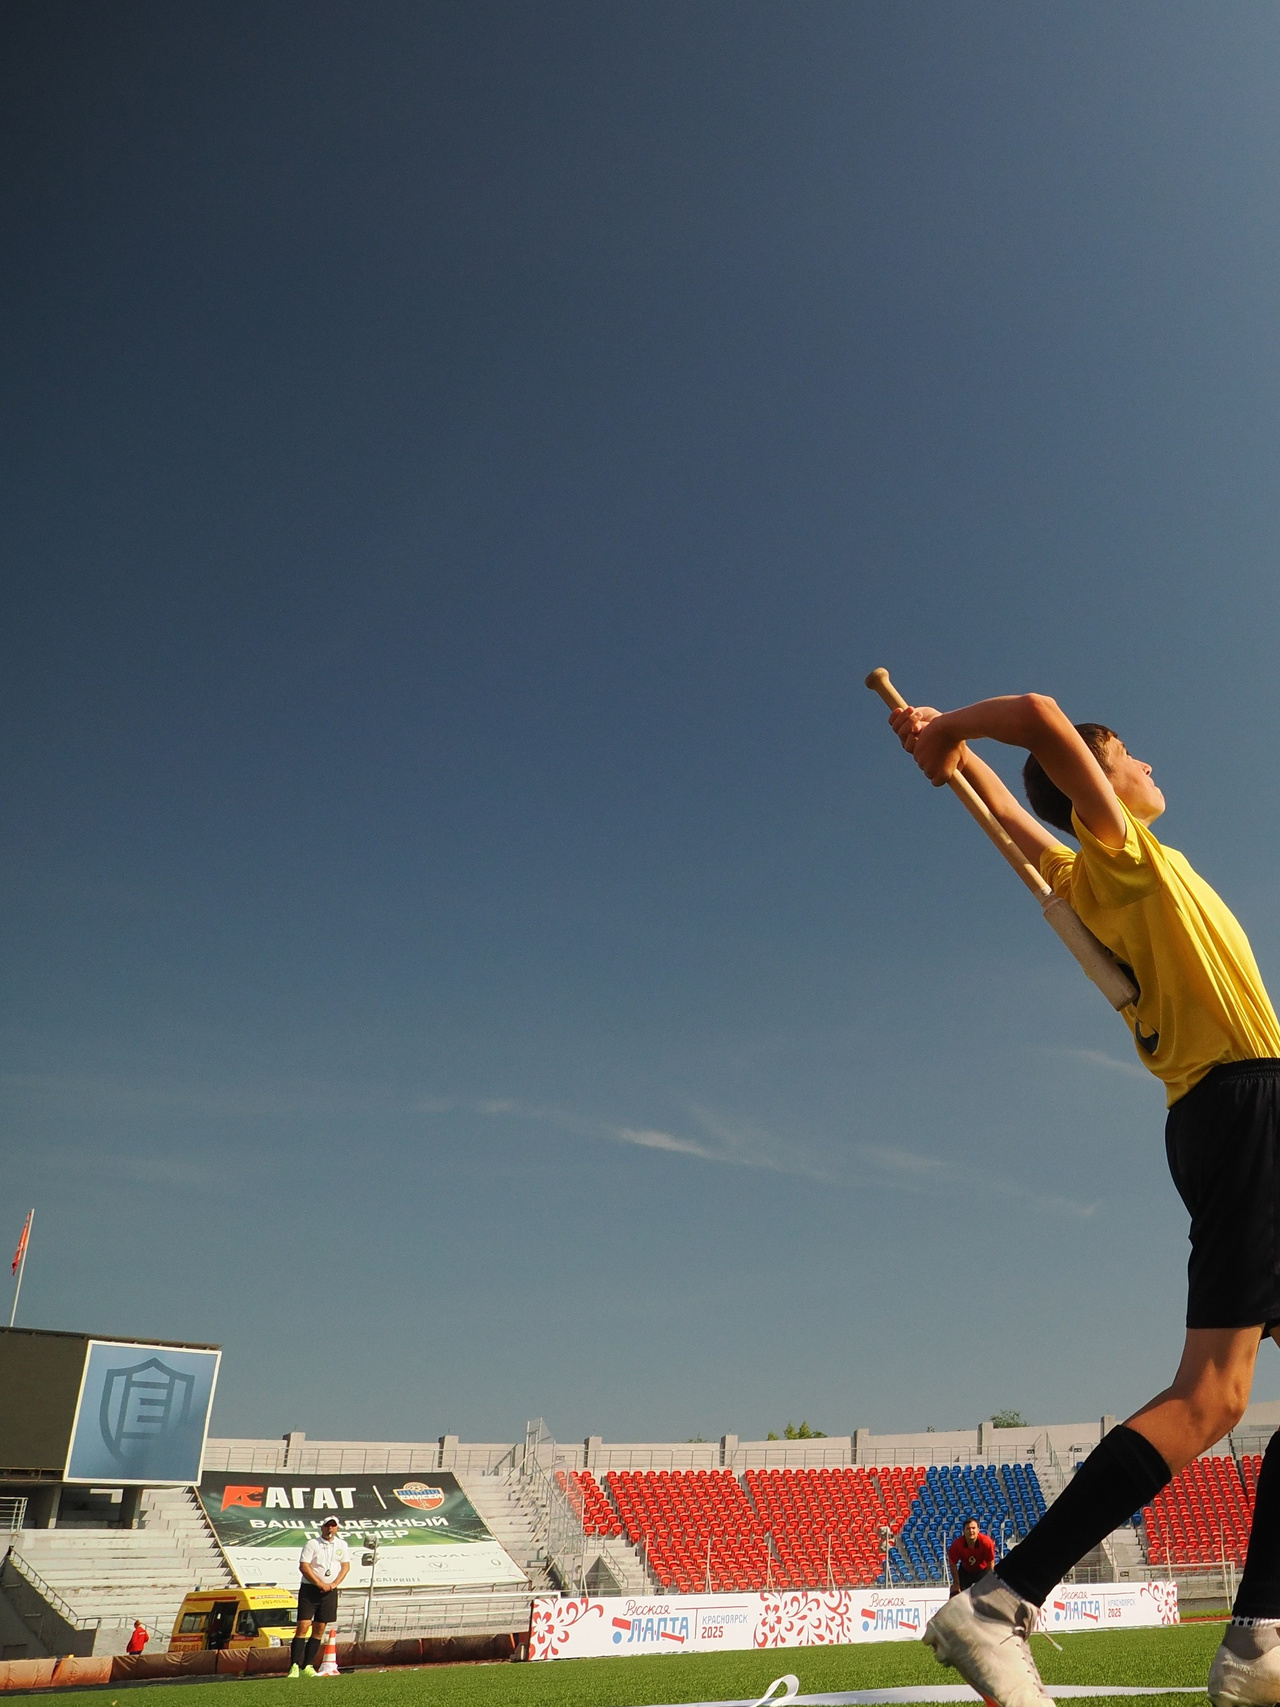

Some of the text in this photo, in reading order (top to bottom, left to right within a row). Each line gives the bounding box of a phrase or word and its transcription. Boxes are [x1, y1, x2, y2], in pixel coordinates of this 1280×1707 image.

[264, 1487, 357, 1509] АГАТ
[250, 1519, 305, 1529] ВАШ
[304, 1530, 410, 1540] ПРТНЕР
[1064, 1600, 1101, 1621] ЛАПТА
[1107, 1608, 1122, 1618] 2025
[702, 1614, 748, 1625] КРАСНОЯРСК
[874, 1608, 921, 1630] ЛАПТА
[627, 1617, 689, 1643] ЛАПТА
[701, 1626, 724, 1639] 2025
